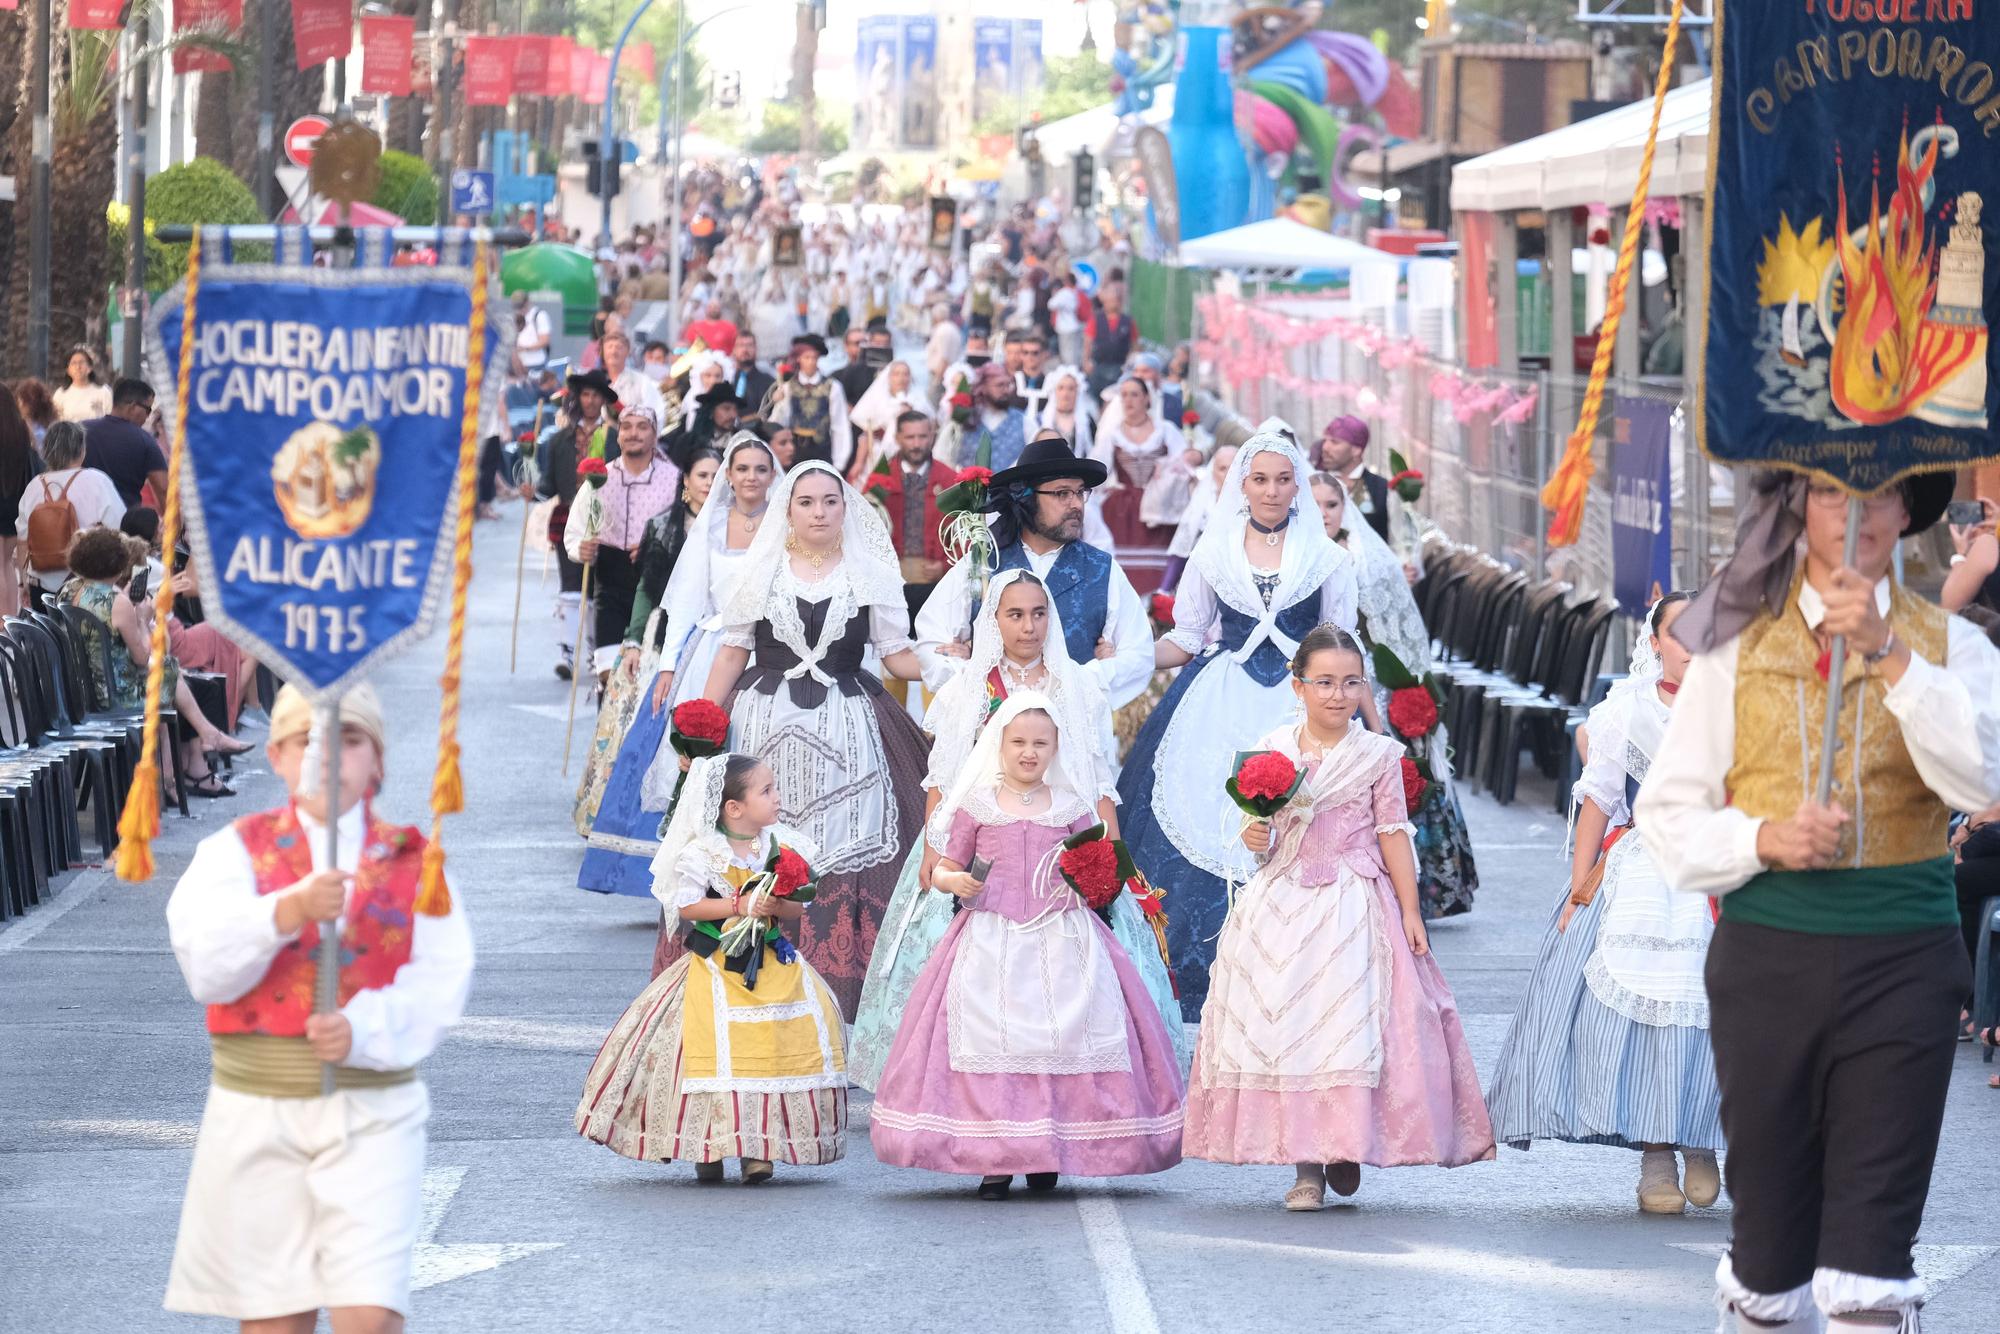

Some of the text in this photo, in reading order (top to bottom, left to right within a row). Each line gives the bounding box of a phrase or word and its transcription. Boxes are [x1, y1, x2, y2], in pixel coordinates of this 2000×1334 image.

[194, 319, 349, 374] HOGUERA
[196, 367, 453, 423] CAMPOAMOR
[224, 535, 418, 592] ALICANTE
[280, 601, 367, 654] 1975
